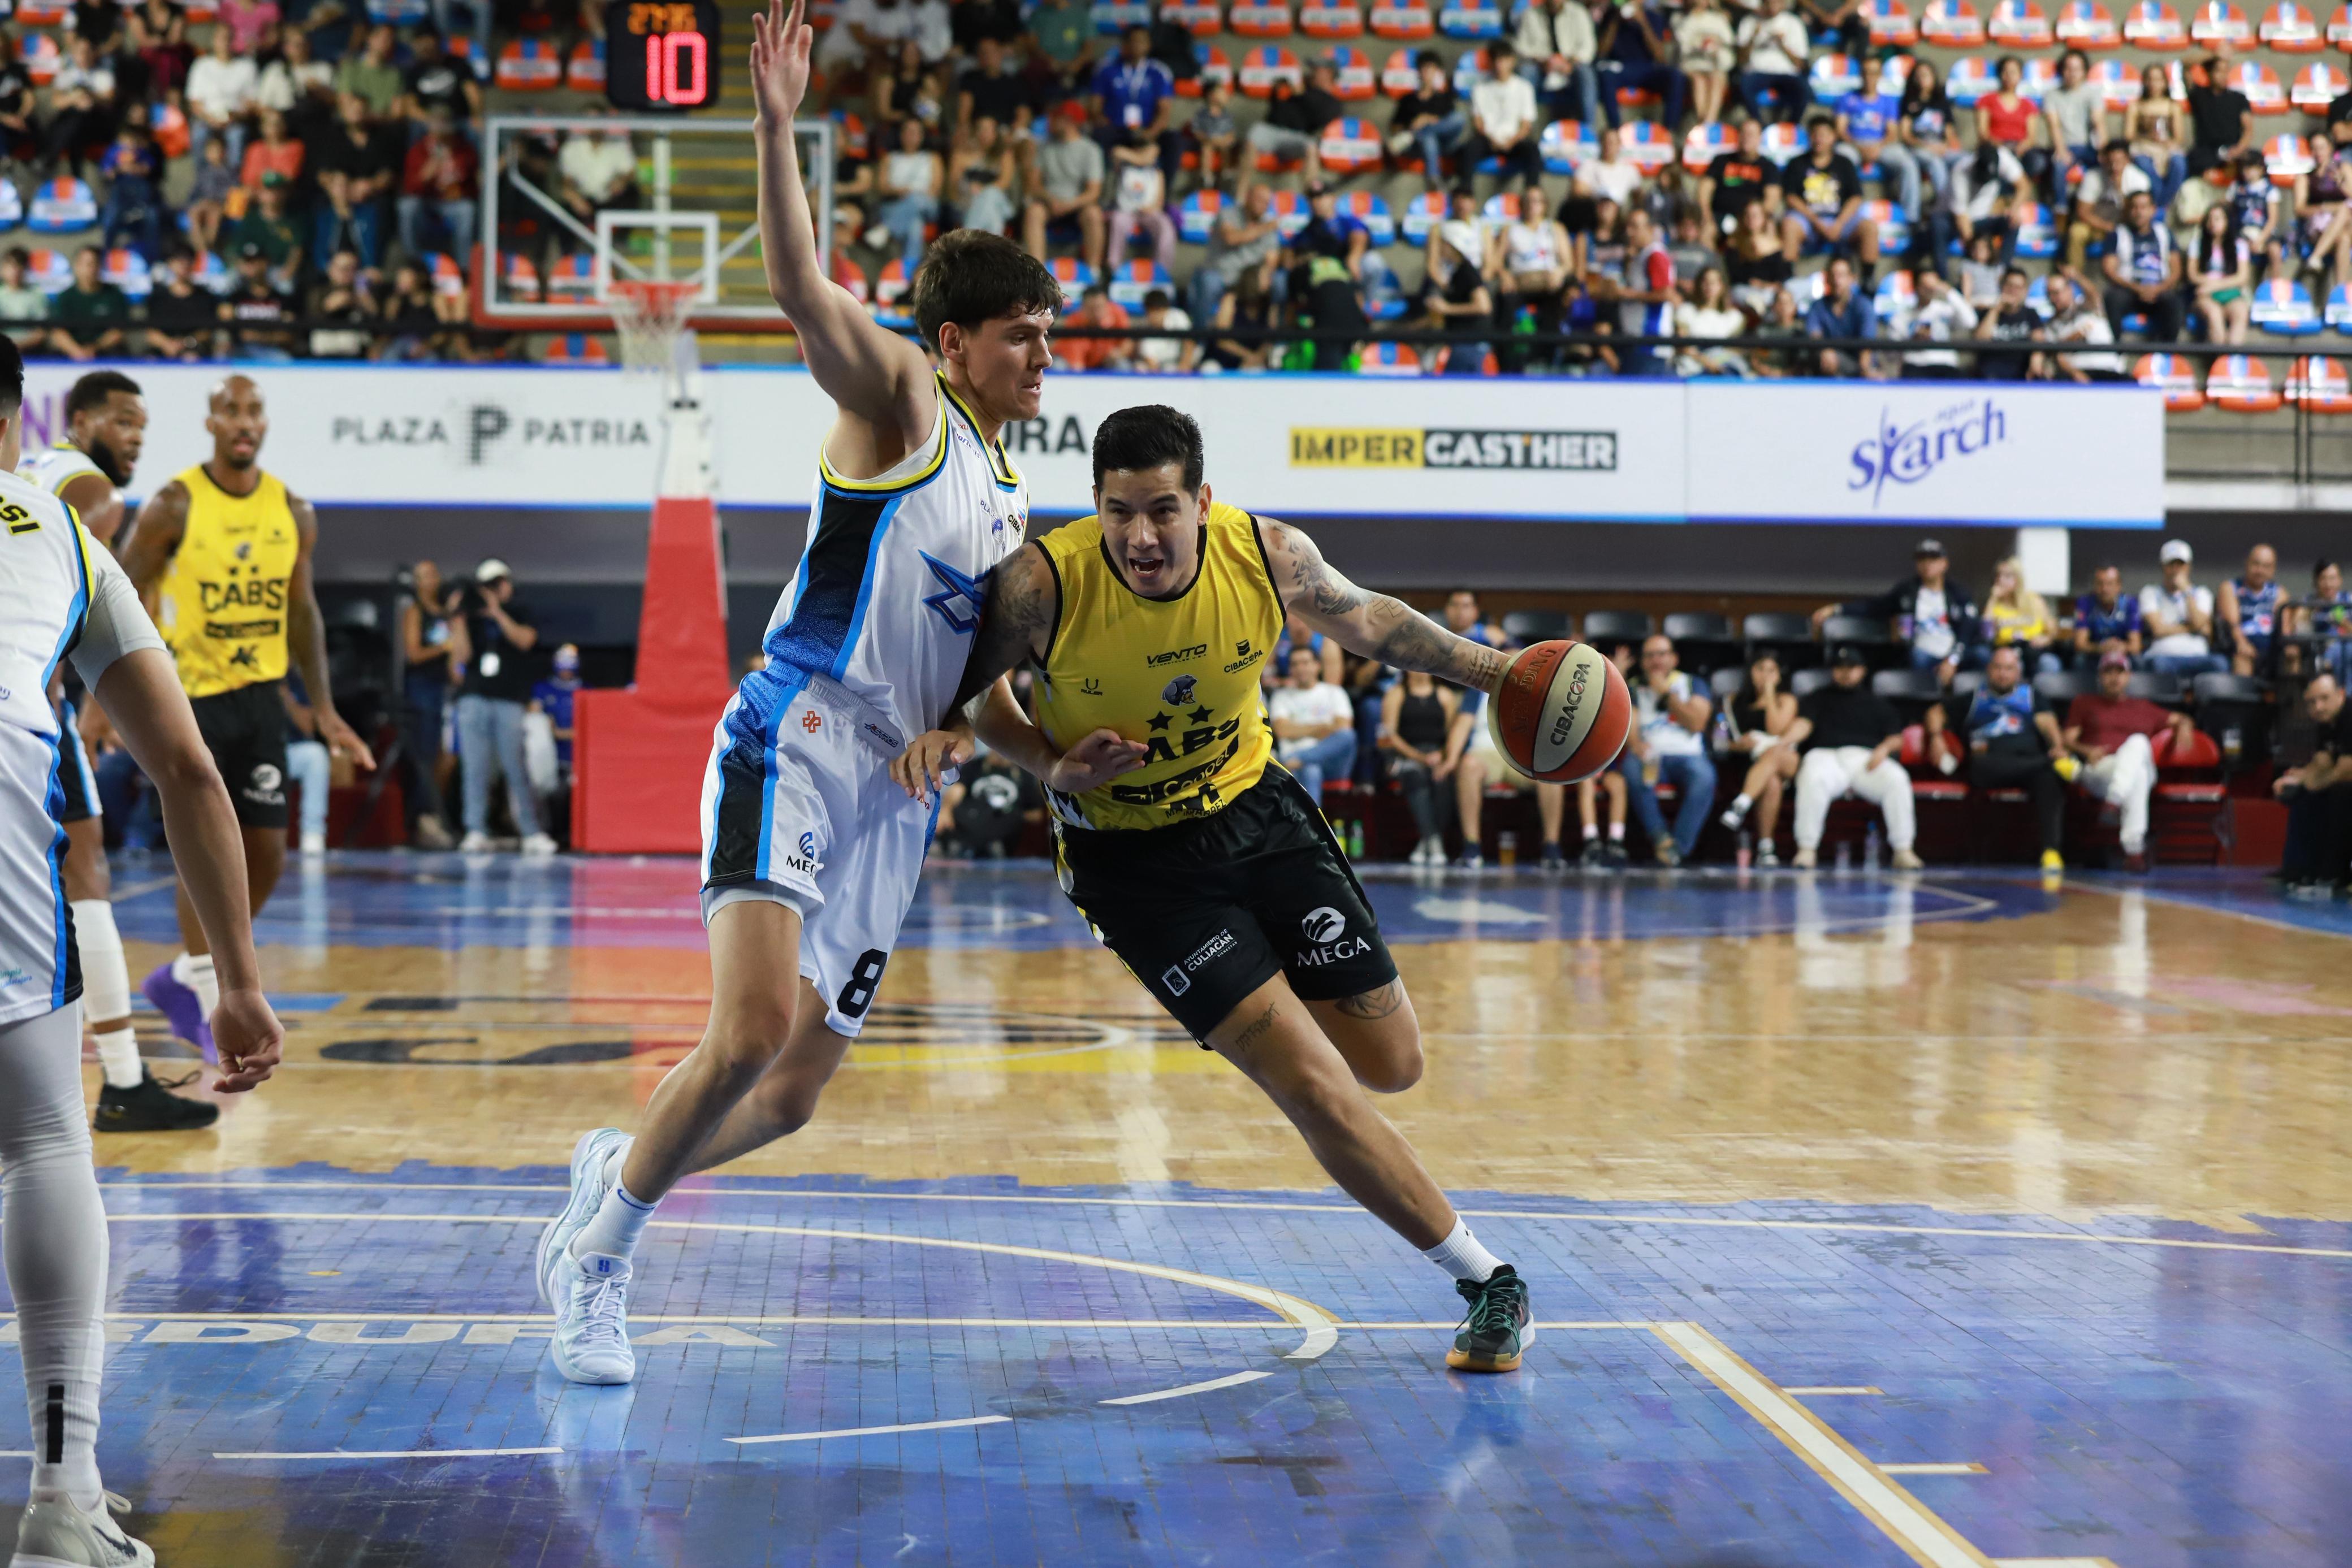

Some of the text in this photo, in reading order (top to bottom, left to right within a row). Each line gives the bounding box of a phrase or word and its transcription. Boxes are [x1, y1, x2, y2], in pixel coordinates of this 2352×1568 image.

[646, 33, 707, 105] 10
[332, 417, 448, 444] PLAZA
[525, 418, 650, 445] PATRIA
[1294, 431, 1615, 467] IMPER CASTHER
[0, 495, 40, 534] SI
[199, 579, 284, 613] CABS
[1147, 643, 1207, 665] VENTO
[1224, 649, 1263, 673] CIBACOPA
[1550, 664, 1591, 746] CIBACOPA
[1140, 712, 1243, 768] ABS
[1183, 928, 1228, 965] AYUNTAMIENTO DE
[1187, 933, 1234, 971] CULIACÁN
[1217, 941, 1238, 958] BIENESTAR
[1298, 936, 1372, 967] MEGA
[837, 948, 888, 1019] 8
